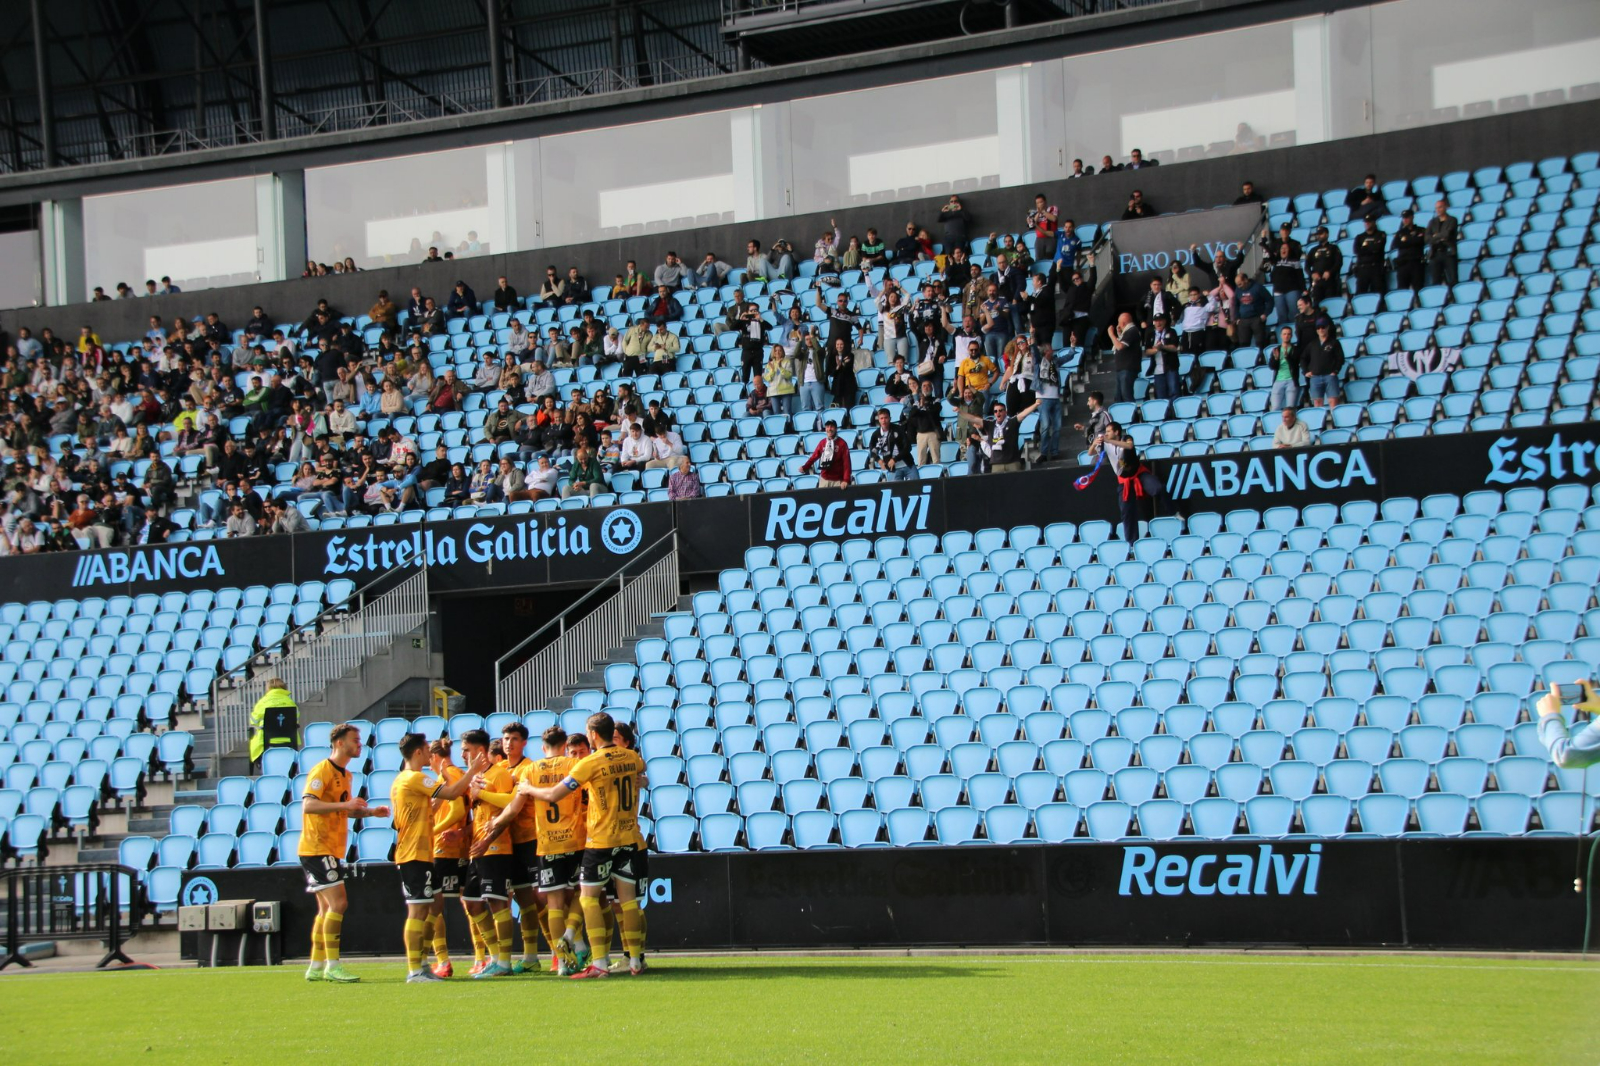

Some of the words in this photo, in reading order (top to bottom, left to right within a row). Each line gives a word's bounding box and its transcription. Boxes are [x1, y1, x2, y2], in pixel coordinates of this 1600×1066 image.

[1119, 251, 1169, 274] FARO
[765, 485, 932, 541] Recalvi
[324, 530, 459, 575] Estrella
[465, 517, 592, 563] Galicia
[613, 775, 633, 812] 10
[322, 855, 337, 870] 18
[425, 870, 432, 885] 2
[1118, 843, 1323, 896] Recalvi
